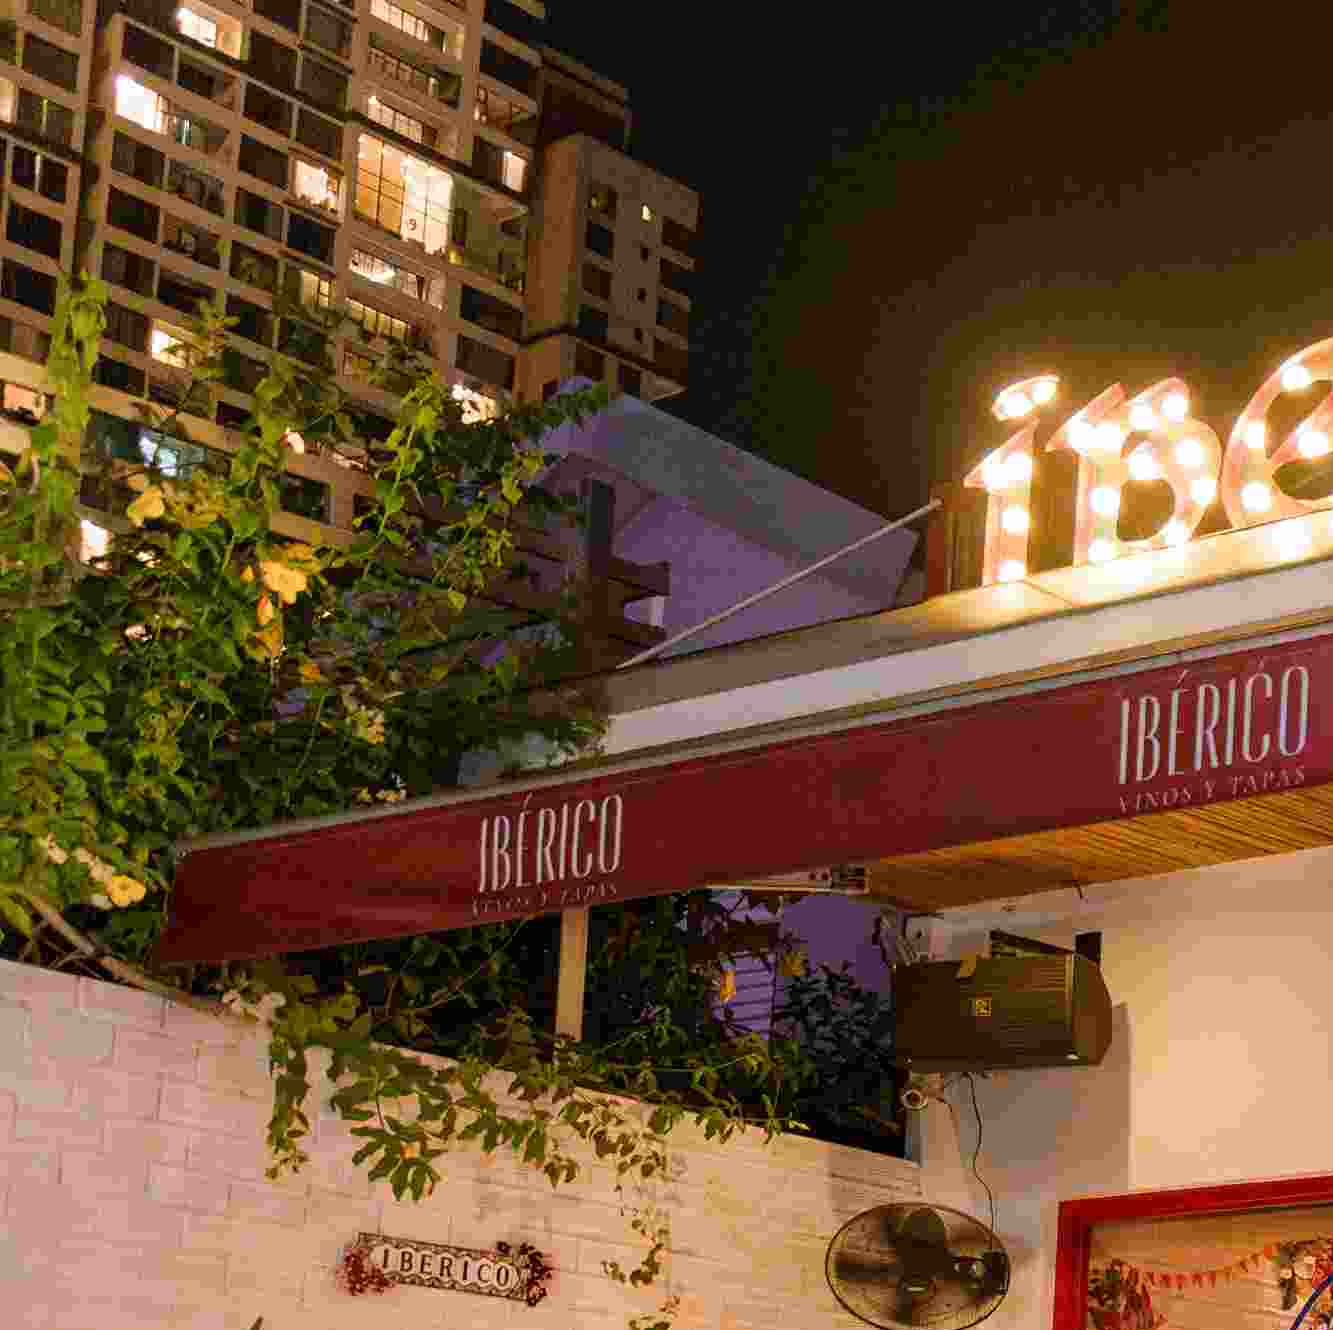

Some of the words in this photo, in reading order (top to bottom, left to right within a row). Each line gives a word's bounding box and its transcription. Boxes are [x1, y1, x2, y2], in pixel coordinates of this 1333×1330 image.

[1118, 665, 1310, 785] IBÉRICO
[478, 791, 624, 893] IBÉRICO
[382, 1247, 510, 1288] IBERICO
